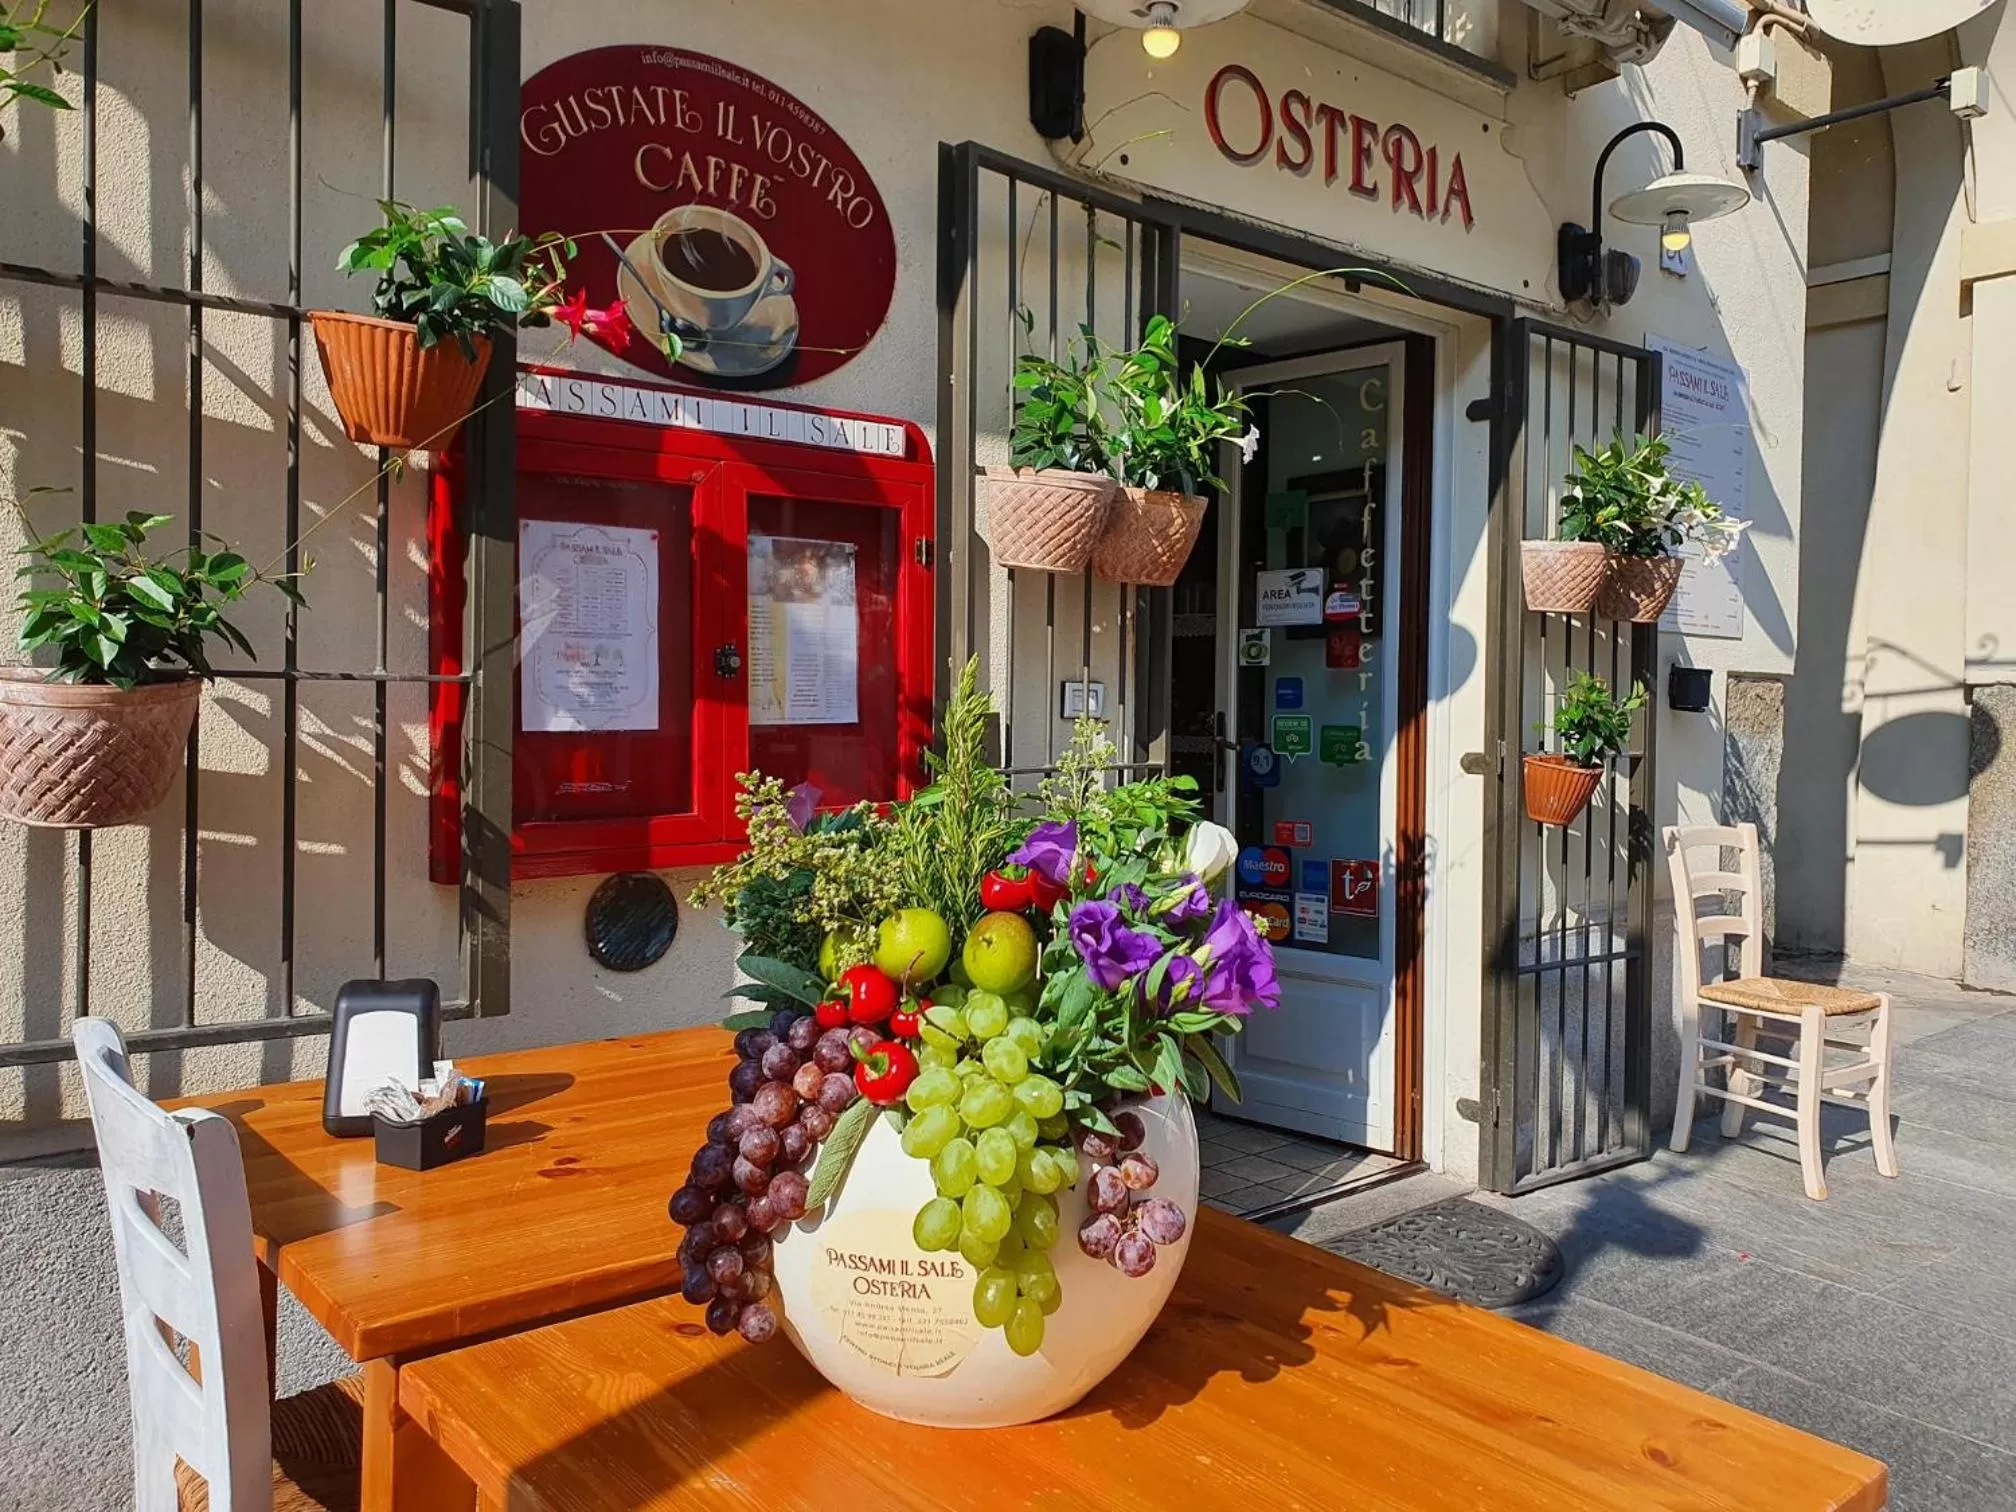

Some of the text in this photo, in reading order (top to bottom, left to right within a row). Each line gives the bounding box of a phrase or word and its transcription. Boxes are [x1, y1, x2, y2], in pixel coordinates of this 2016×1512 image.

[520, 85, 874, 230] GUSTATE IL VOSTRO
[1204, 64, 1475, 234] OSTERIA
[516, 376, 900, 456] ASSAMI IL SALE
[1354, 376, 1384, 761] Caffetteria
[1262, 588, 1291, 601] AREA
[1243, 860, 1285, 872] Maestro
[1239, 891, 1290, 902] EUROCARD
[825, 1247, 964, 1279] PASSAMI IL SALE
[853, 1276, 932, 1299] OSTERIA
